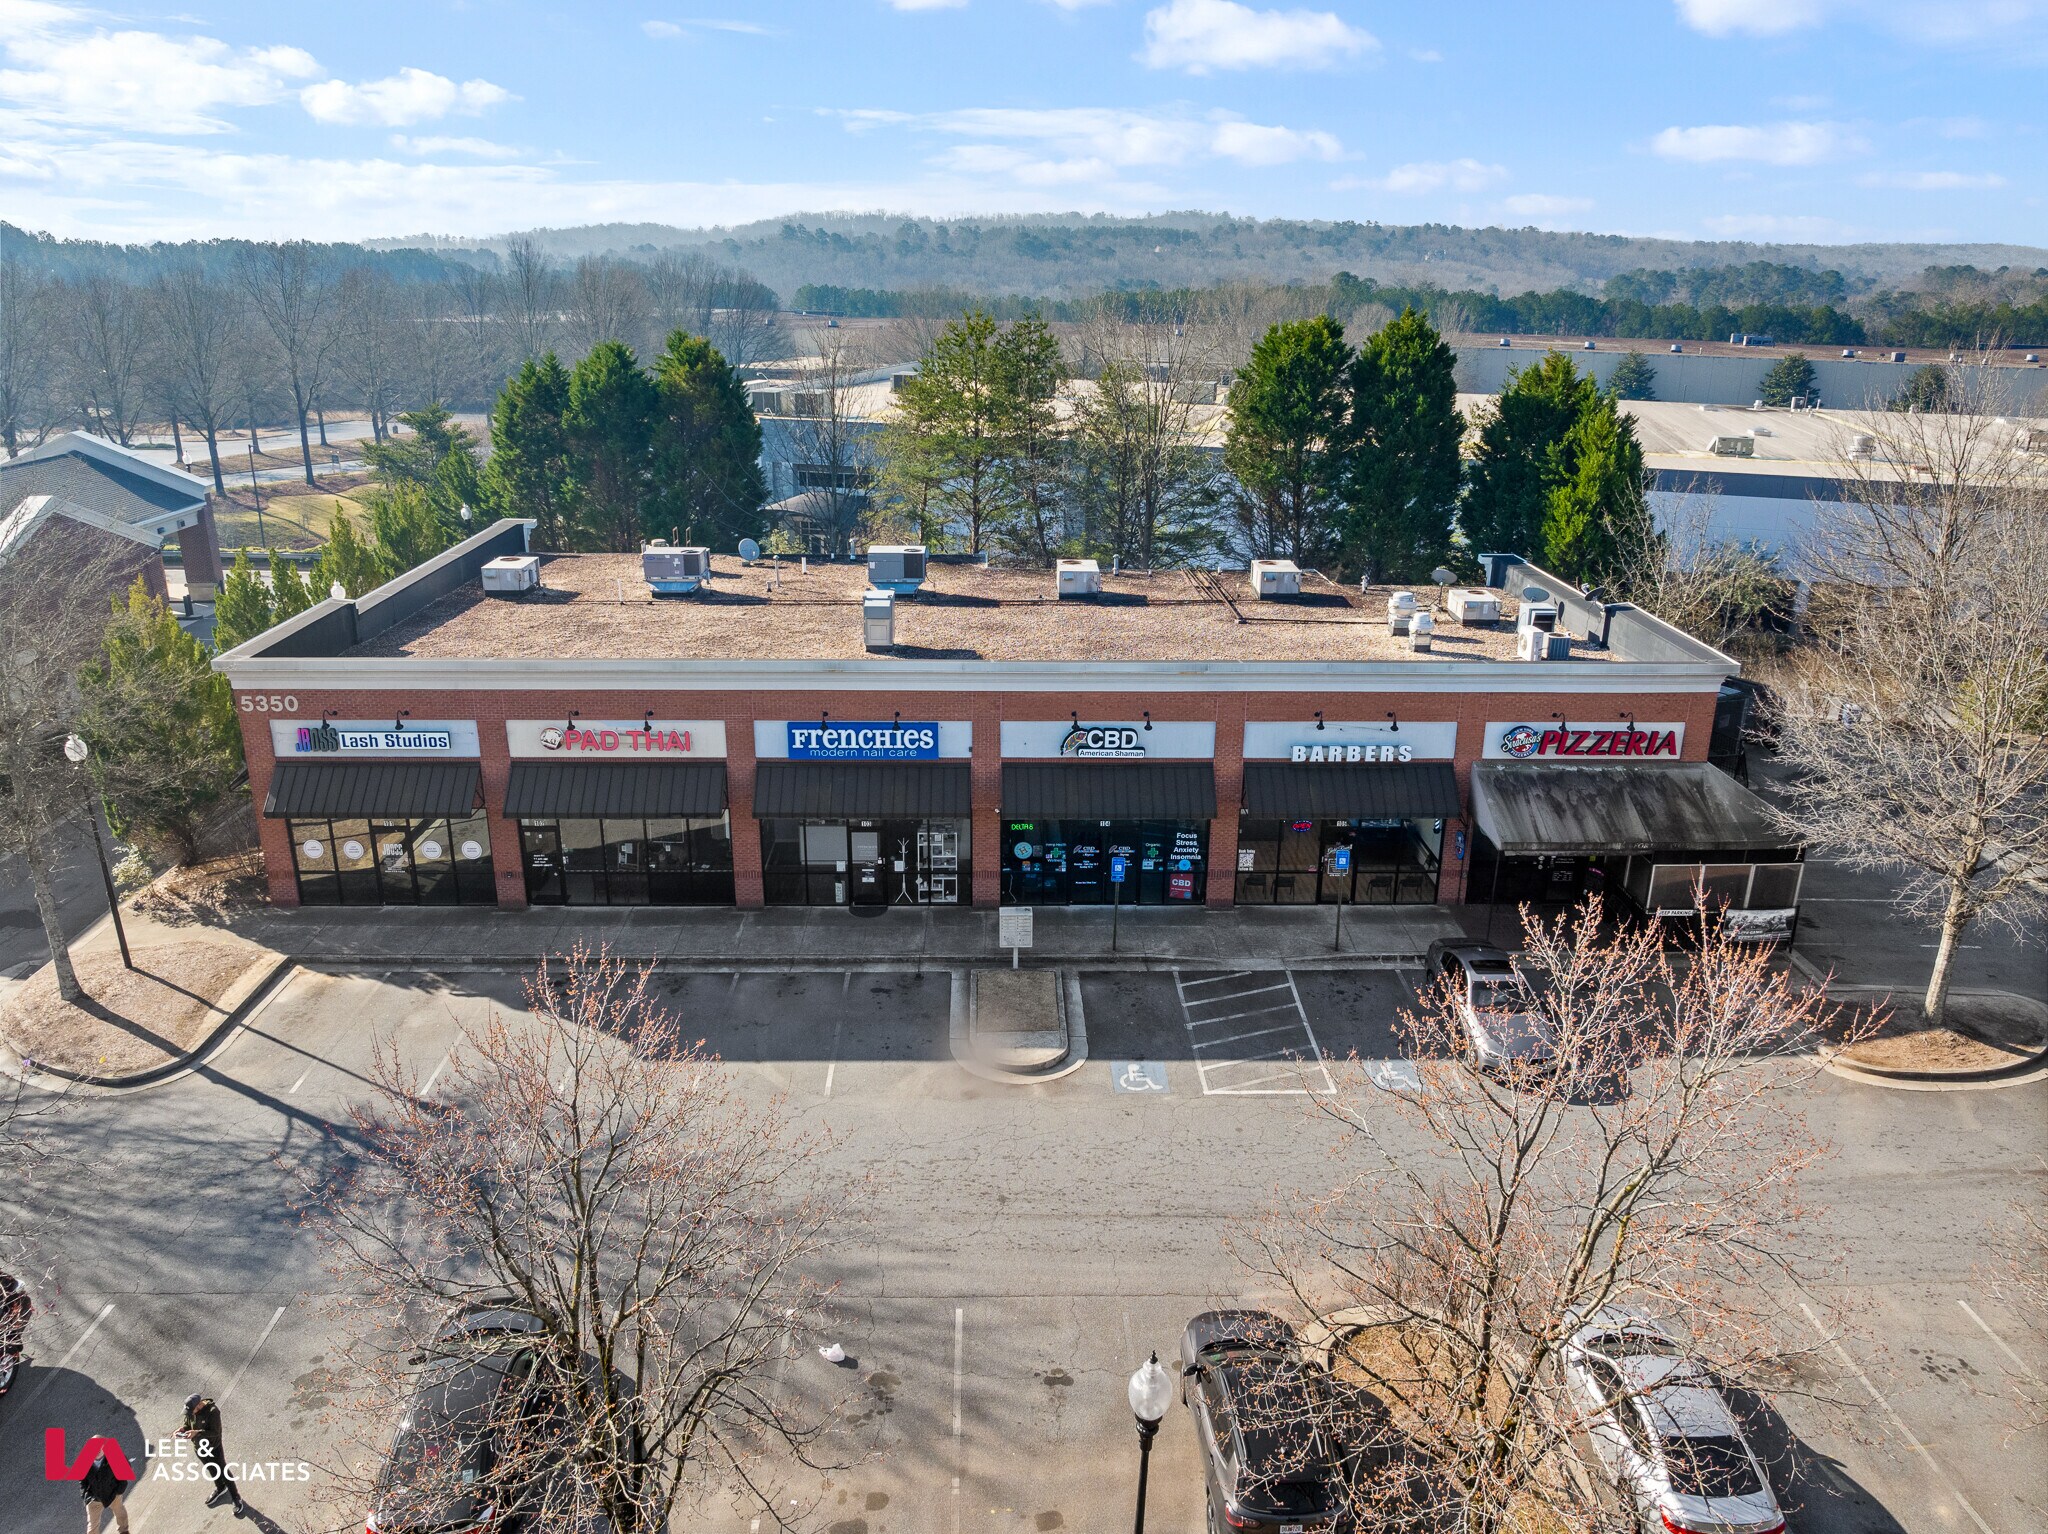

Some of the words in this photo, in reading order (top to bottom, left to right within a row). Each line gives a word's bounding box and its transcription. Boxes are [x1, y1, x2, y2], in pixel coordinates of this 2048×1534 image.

[241, 695, 299, 712] 5350
[295, 728, 338, 752] JBOSS
[341, 734, 378, 748] Lash
[385, 734, 448, 748] Studios
[565, 729, 620, 751] PAD
[626, 730, 691, 751] THAI
[1087, 729, 1138, 748] CBD
[1537, 730, 1678, 756] PIZZERIA
[810, 748, 858, 757] modern
[863, 748, 884, 757] nail
[1291, 745, 1413, 762] BARBERS
[1171, 878, 1191, 887] CBD
